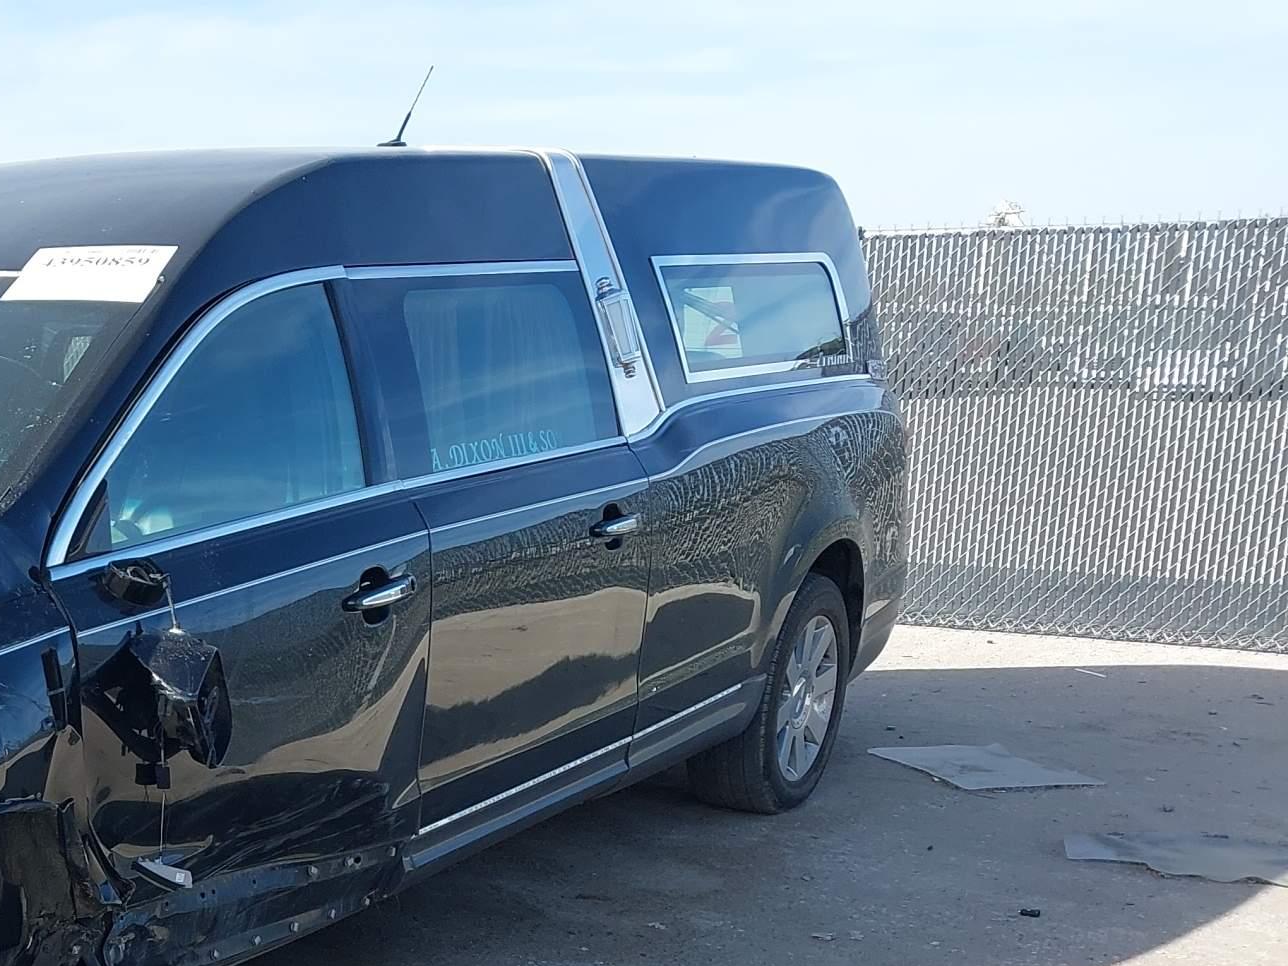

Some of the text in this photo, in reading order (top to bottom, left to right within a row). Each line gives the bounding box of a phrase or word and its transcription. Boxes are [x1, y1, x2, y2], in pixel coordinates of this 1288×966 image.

[449, 433, 506, 467] DIXON
[508, 433, 527, 457] III
[528, 431, 540, 453] &
